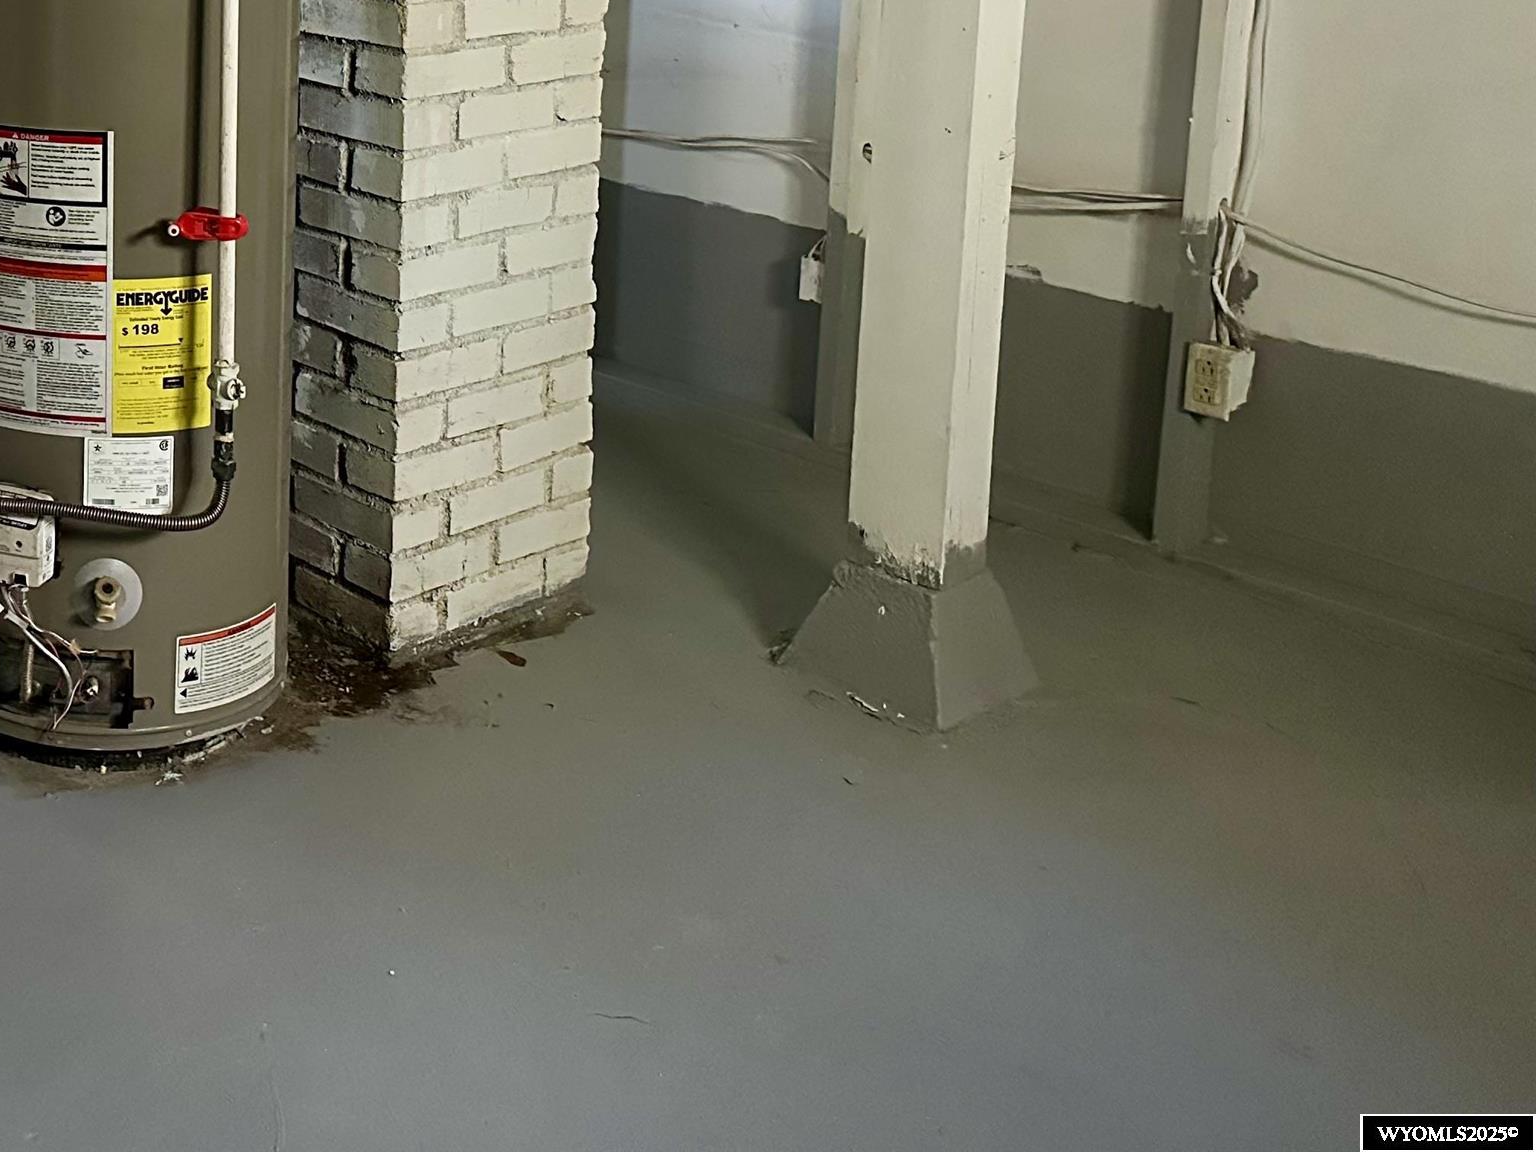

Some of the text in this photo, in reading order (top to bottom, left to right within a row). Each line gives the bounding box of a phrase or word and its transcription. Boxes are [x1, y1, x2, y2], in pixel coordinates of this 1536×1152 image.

[20, 132, 50, 141] DANGER
[116, 287, 209, 308] ENERGYGUIDE
[132, 323, 159, 336] 198
